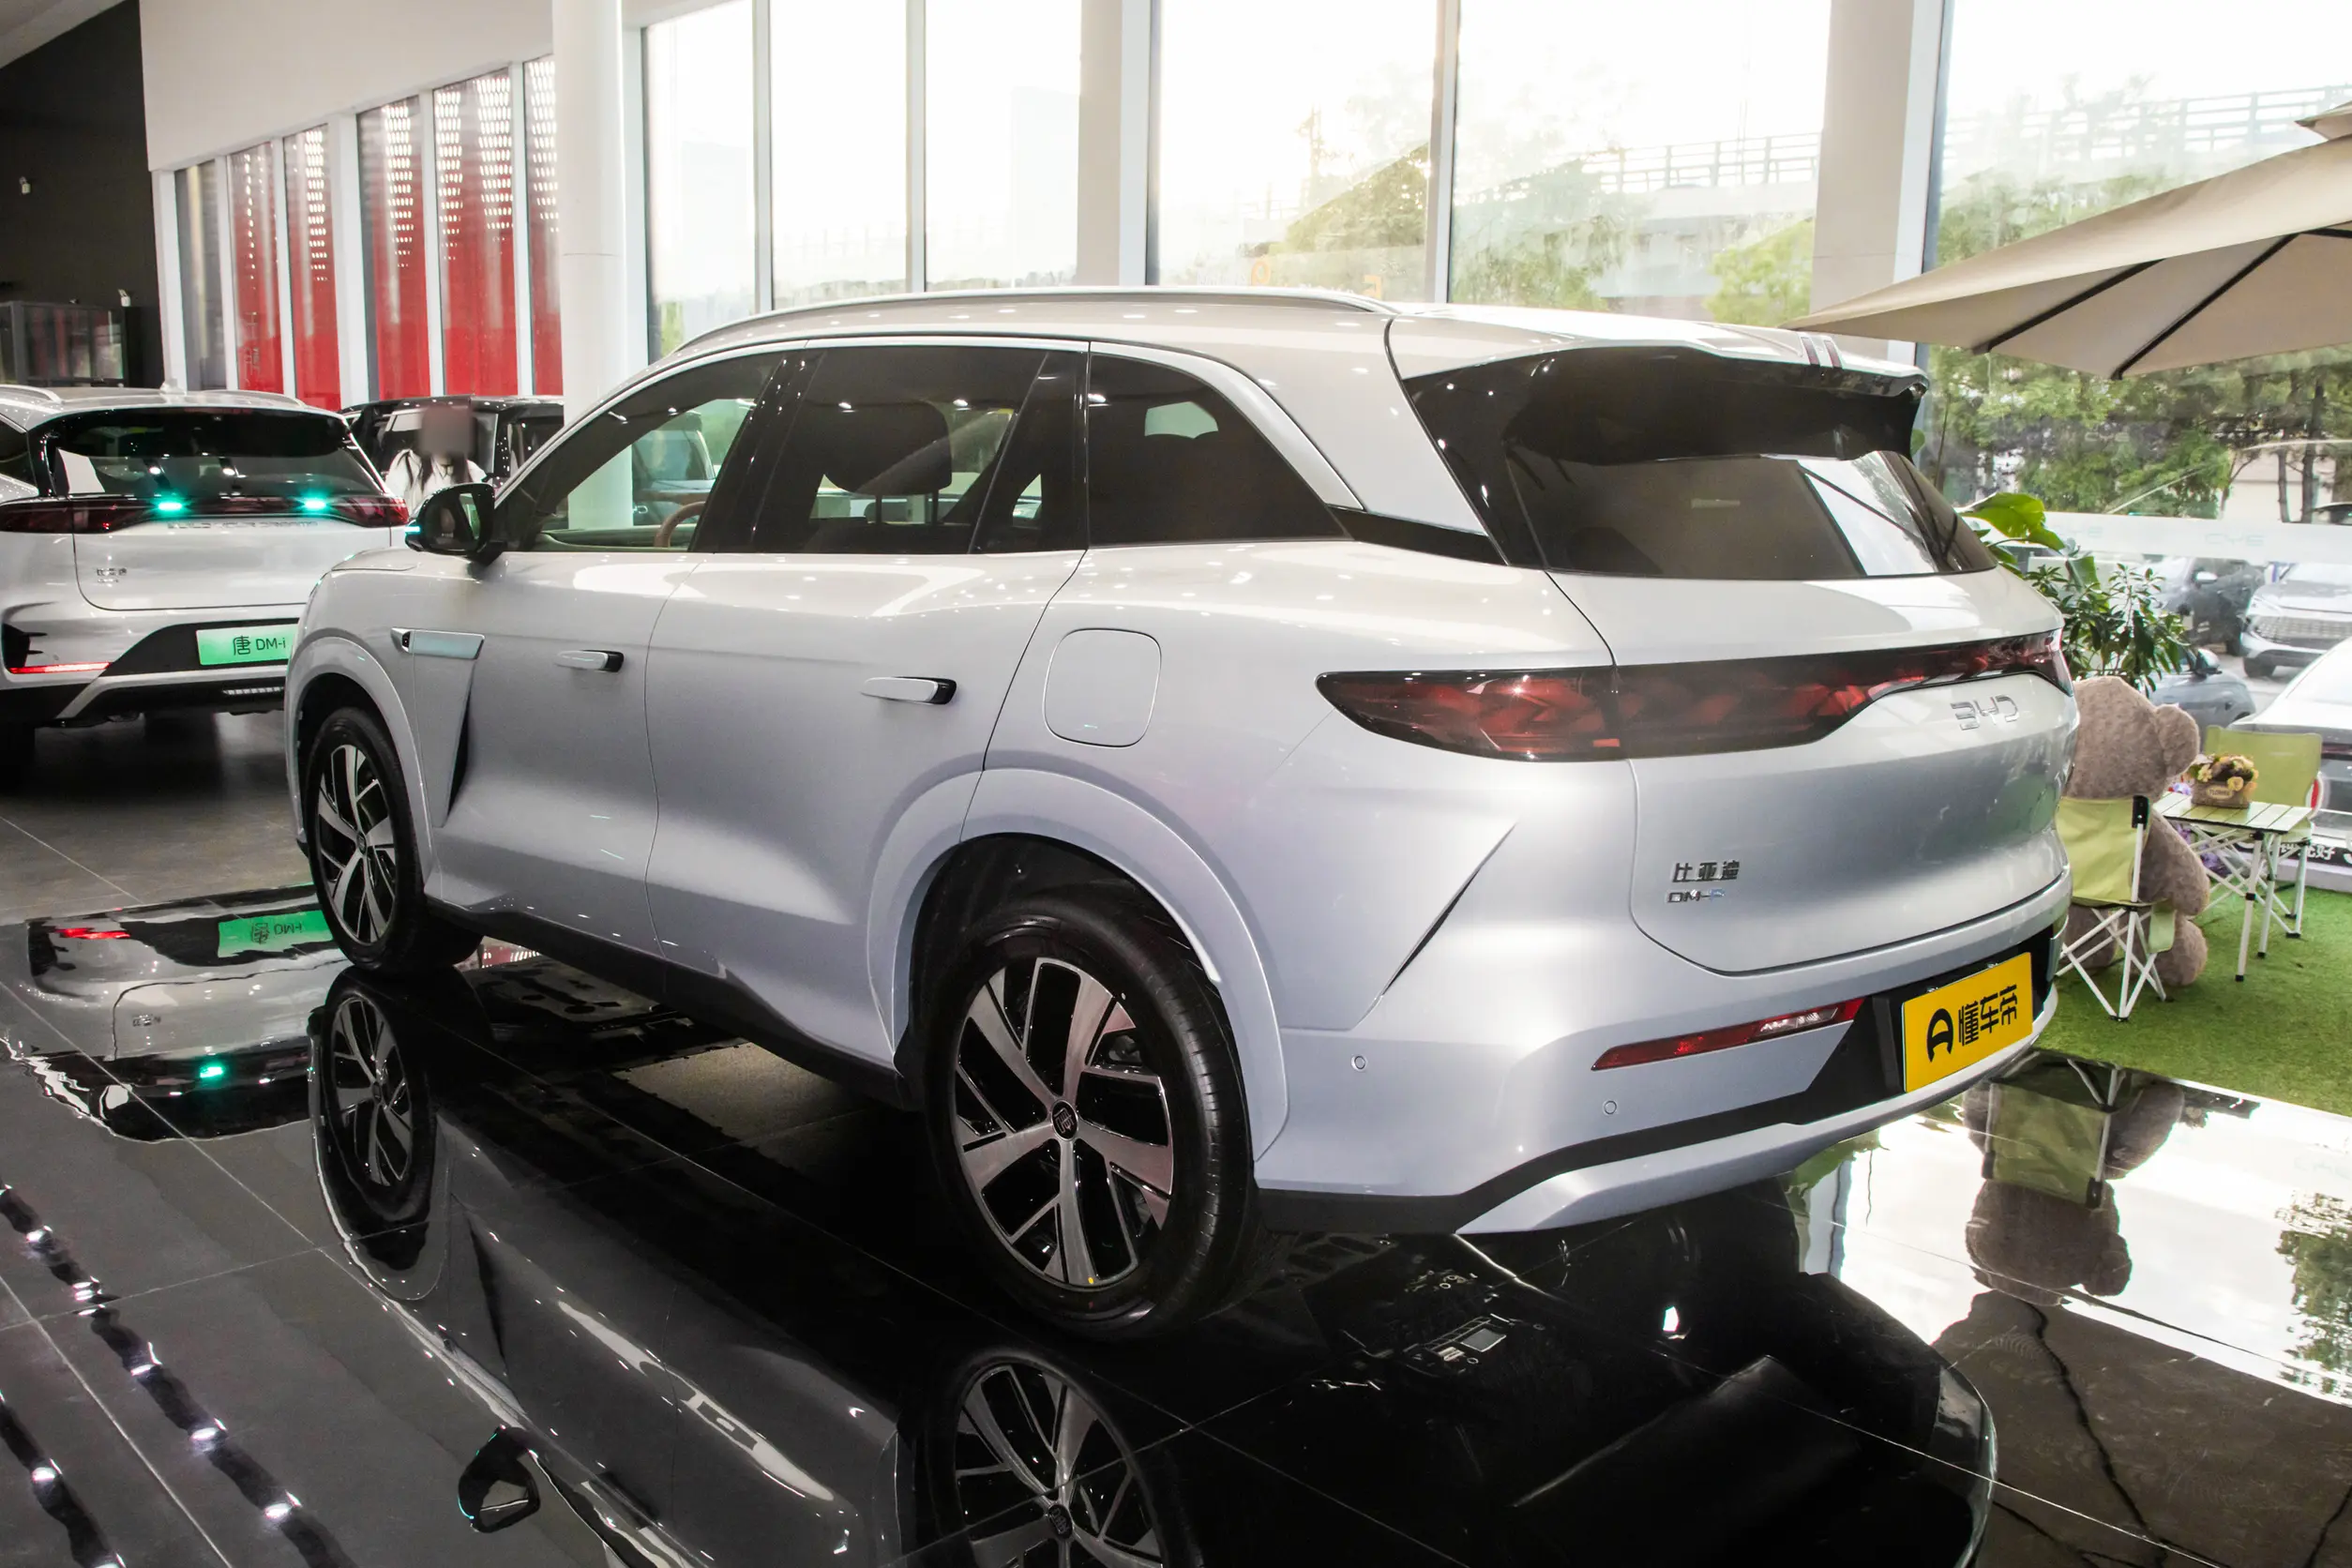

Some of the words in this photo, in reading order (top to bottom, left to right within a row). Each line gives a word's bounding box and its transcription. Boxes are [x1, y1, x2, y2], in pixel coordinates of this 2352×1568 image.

[233, 635, 251, 656] 唐
[255, 638, 286, 651] DM-i
[1950, 695, 2018, 731] BYD
[1671, 860, 1741, 882] 比亚迪
[1958, 984, 2018, 1048] 懂车帝
